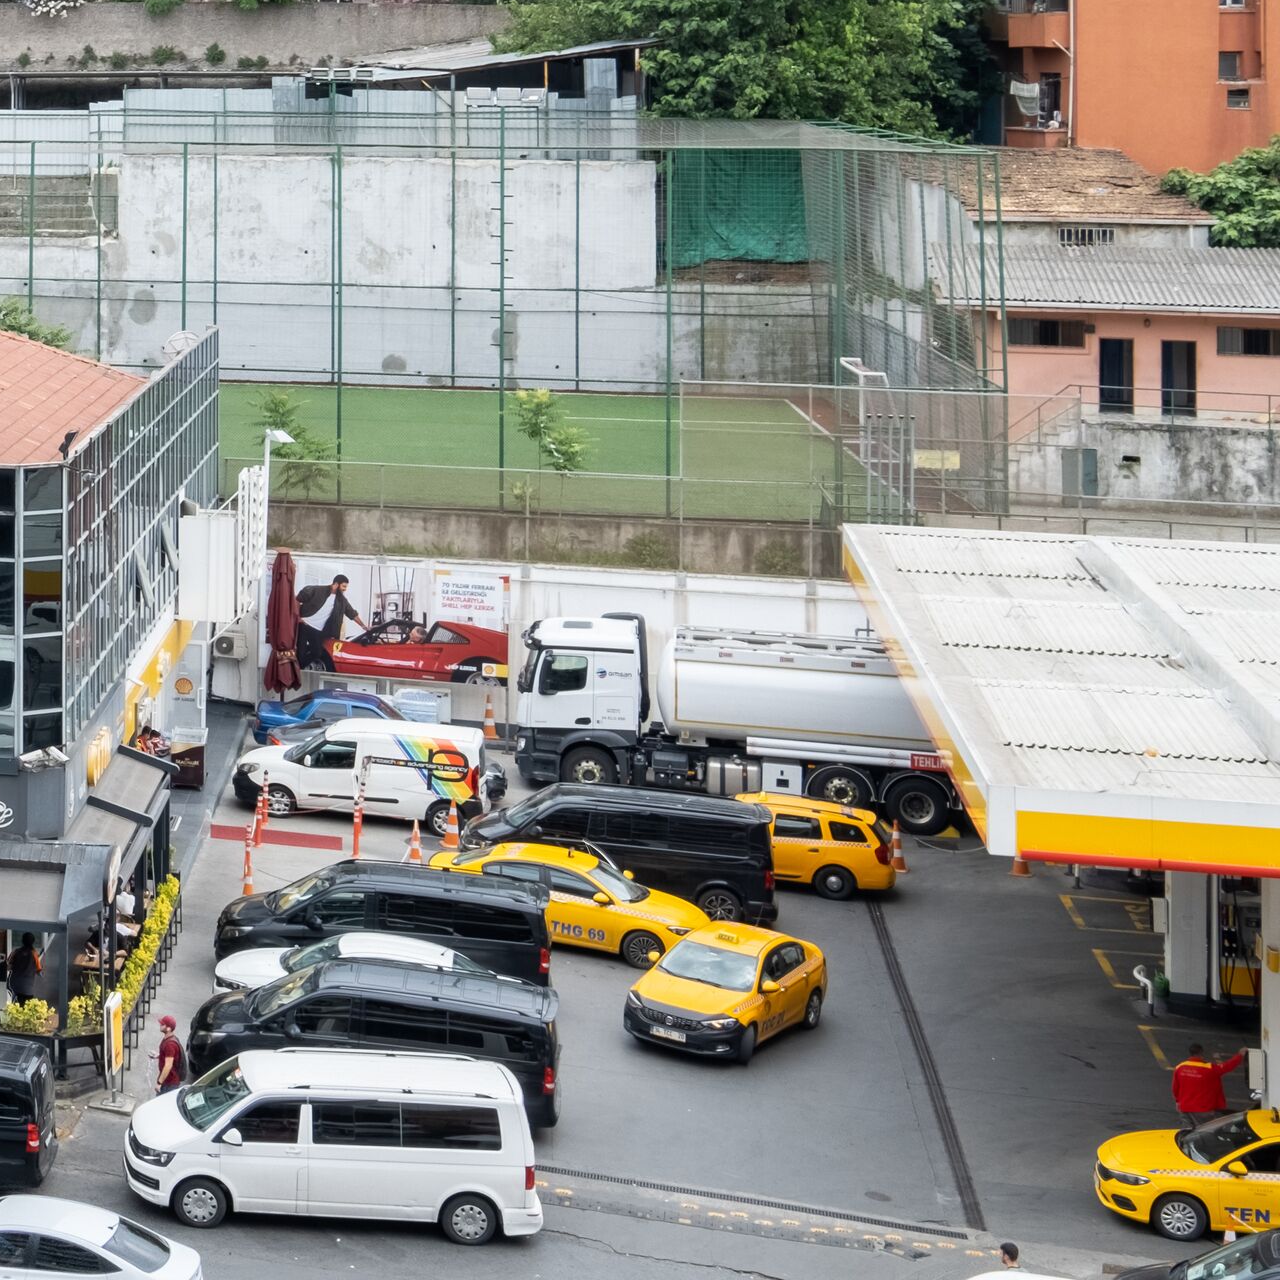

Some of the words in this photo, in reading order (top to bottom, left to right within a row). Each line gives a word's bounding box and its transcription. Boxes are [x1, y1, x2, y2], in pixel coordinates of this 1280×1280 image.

[551, 920, 583, 938] THG
[588, 927, 606, 942] 69
[1224, 1206, 1270, 1224] TEN
